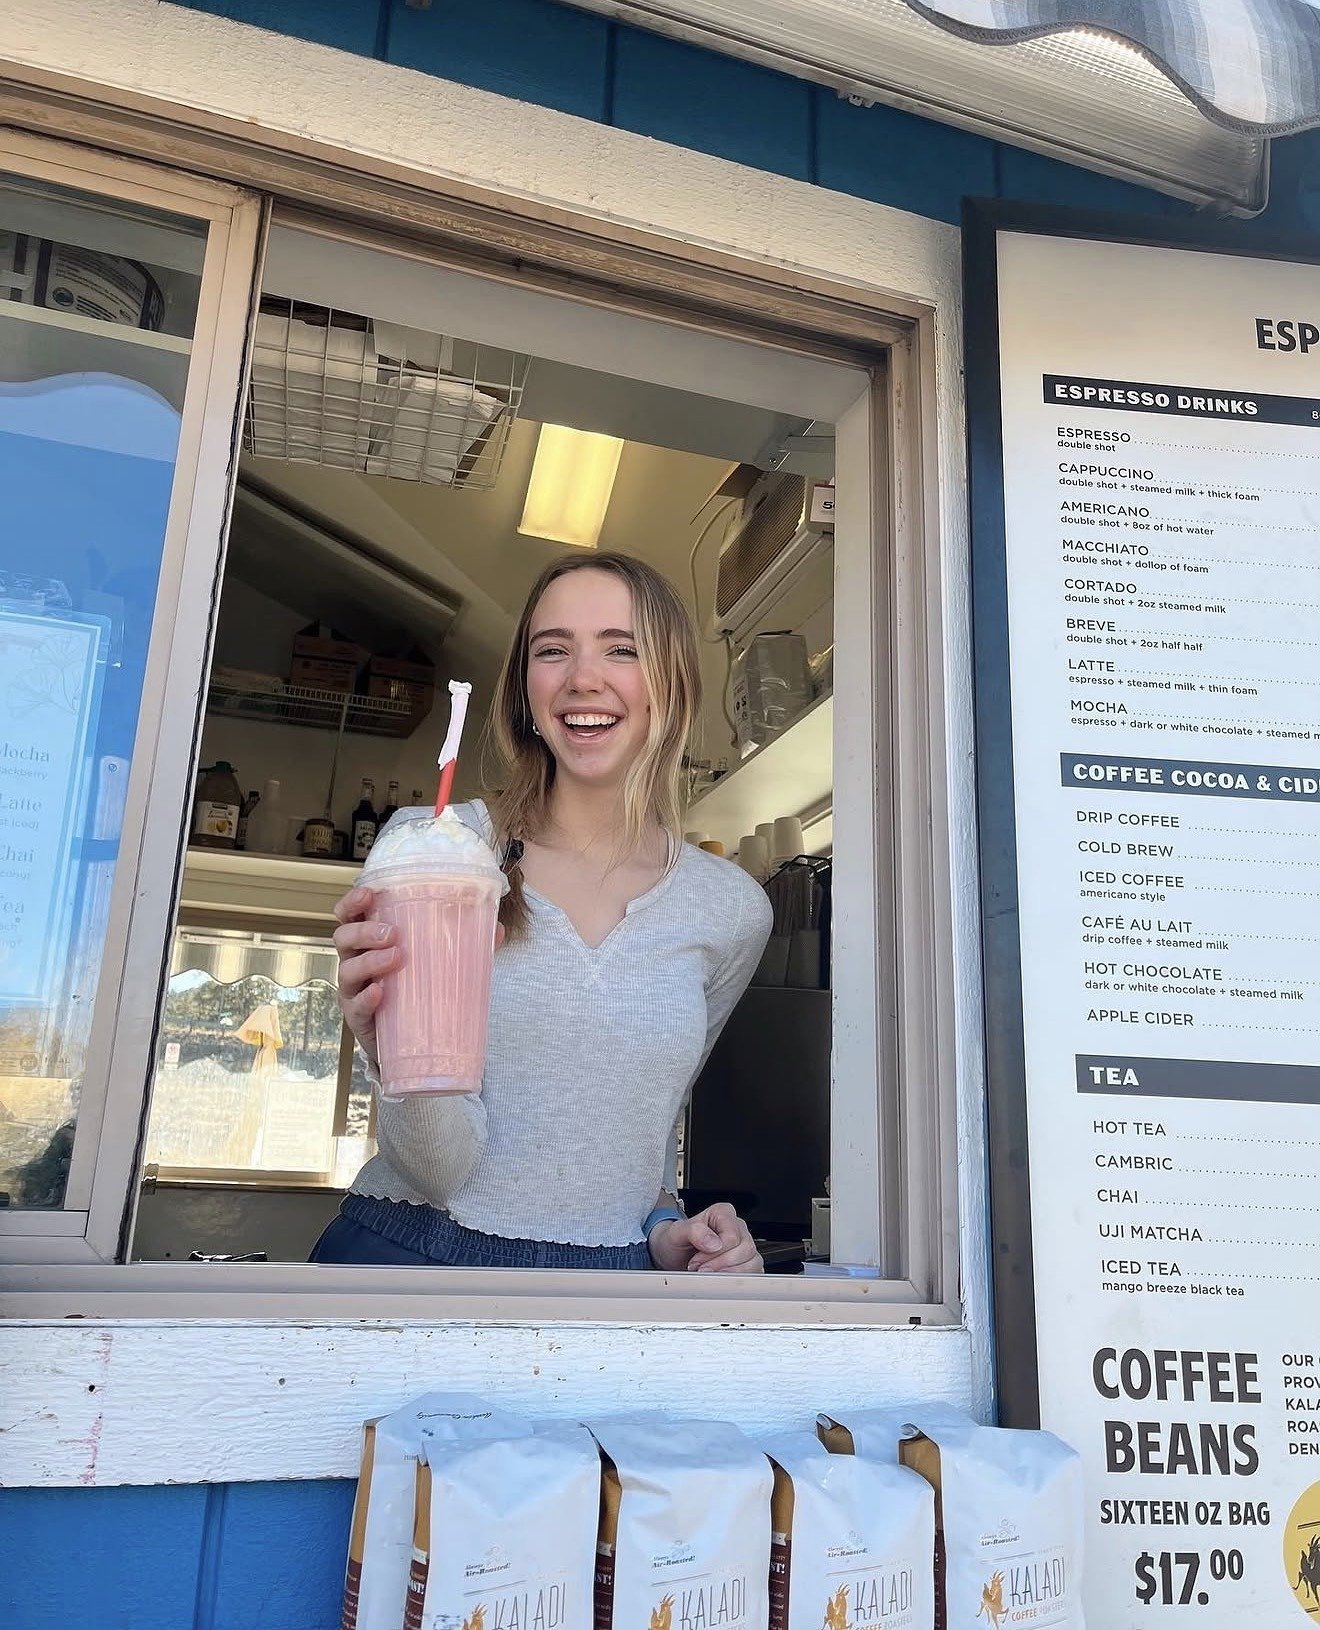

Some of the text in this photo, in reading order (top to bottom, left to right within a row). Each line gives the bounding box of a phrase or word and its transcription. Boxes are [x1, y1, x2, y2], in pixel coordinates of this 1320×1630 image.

[1056, 385, 1257, 414] ESPRESSO DRINKS
[1058, 427, 1130, 442] ESPRESSO
[1058, 440, 1115, 452] double shot
[1059, 463, 1153, 480] CAPPUCCINO
[1059, 478, 1093, 487] double
[1097, 481, 1117, 489] shot
[1131, 485, 1171, 494] steamed
[1235, 492, 1259, 501] foam
[1061, 501, 1149, 517] AMERICANO
[1061, 516, 1095, 525] double
[1099, 519, 1119, 527] shot
[1063, 540, 1148, 555] MACCHIATO
[1063, 555, 1097, 564] double
[1101, 558, 1122, 566] shot
[1135, 561, 1166, 570] dollop
[1184, 564, 1208, 573] foam
[1065, 579, 1136, 593] CORTADO
[1065, 594, 1099, 603] double
[1104, 597, 1124, 605] shot
[1138, 600, 1155, 608] 2oz
[1159, 602, 1201, 611] steamed
[1205, 605, 1226, 613] milk
[1067, 619, 1115, 631] BREVE
[1067, 634, 1102, 643] double
[1106, 637, 1127, 645] shot
[1141, 640, 1158, 648] 2oz
[1162, 641, 1180, 649] half
[1184, 643, 1202, 651] half
[1069, 659, 1114, 672] LATTE
[1069, 676, 1114, 685] espresso
[1128, 680, 1170, 689] steamed
[1232, 686, 1257, 695] foam
[1071, 700, 1127, 714] MOCHA
[1071, 718, 1116, 726] espresso
[1130, 720, 1152, 728] dark
[1171, 723, 1198, 731] white
[1203, 725, 1252, 735] chocolate
[1267, 730, 1310, 739] steamed
[1074, 764, 1320, 793] COFFEE COCOA & CID
[1077, 811, 1179, 827] DRIP COFFEE
[1078, 841, 1173, 857] COLD BREW
[1080, 871, 1184, 887] ICED COFFEE
[1080, 890, 1165, 902] americano style
[1083, 915, 1192, 932] CAFÉ AU LAIT
[1083, 934, 1104, 944] drip
[1108, 936, 1142, 945] coffee
[1156, 939, 1202, 948] steamed
[1206, 941, 1228, 949] milk
[1085, 962, 1222, 980] HOT CHOCOLATE
[1085, 980, 1109, 989] dark
[1129, 983, 1158, 992] white
[1162, 985, 1215, 995] chocolate
[1230, 989, 1276, 998] steamed
[1281, 991, 1303, 1000] milk
[1087, 1009, 1193, 1026] APPLE CIDER
[1090, 1067, 1139, 1085] TEA
[1094, 1121, 1166, 1136] HOT TEA
[1096, 1155, 1172, 1170] CAMBRIC
[1098, 1190, 1137, 1203] CHAI
[1100, 1224, 1202, 1241] UJI MATCHA
[1102, 1260, 1181, 1276] ICED TEA
[1103, 1282, 1244, 1295] mango breeze black tea
[1283, 1355, 1313, 1366] OUR
[1093, 1348, 1261, 1403] COFFEE
[1288, 1421, 1320, 1432] ROA
[1105, 1421, 1258, 1476] BEANS
[1101, 1500, 1270, 1525] SIXTEEN OZ BAG
[1010, 1557, 1065, 1607] KALADI
[854, 1570, 912, 1622] KALADI
[1011, 1608, 1038, 1621] COFFEE
